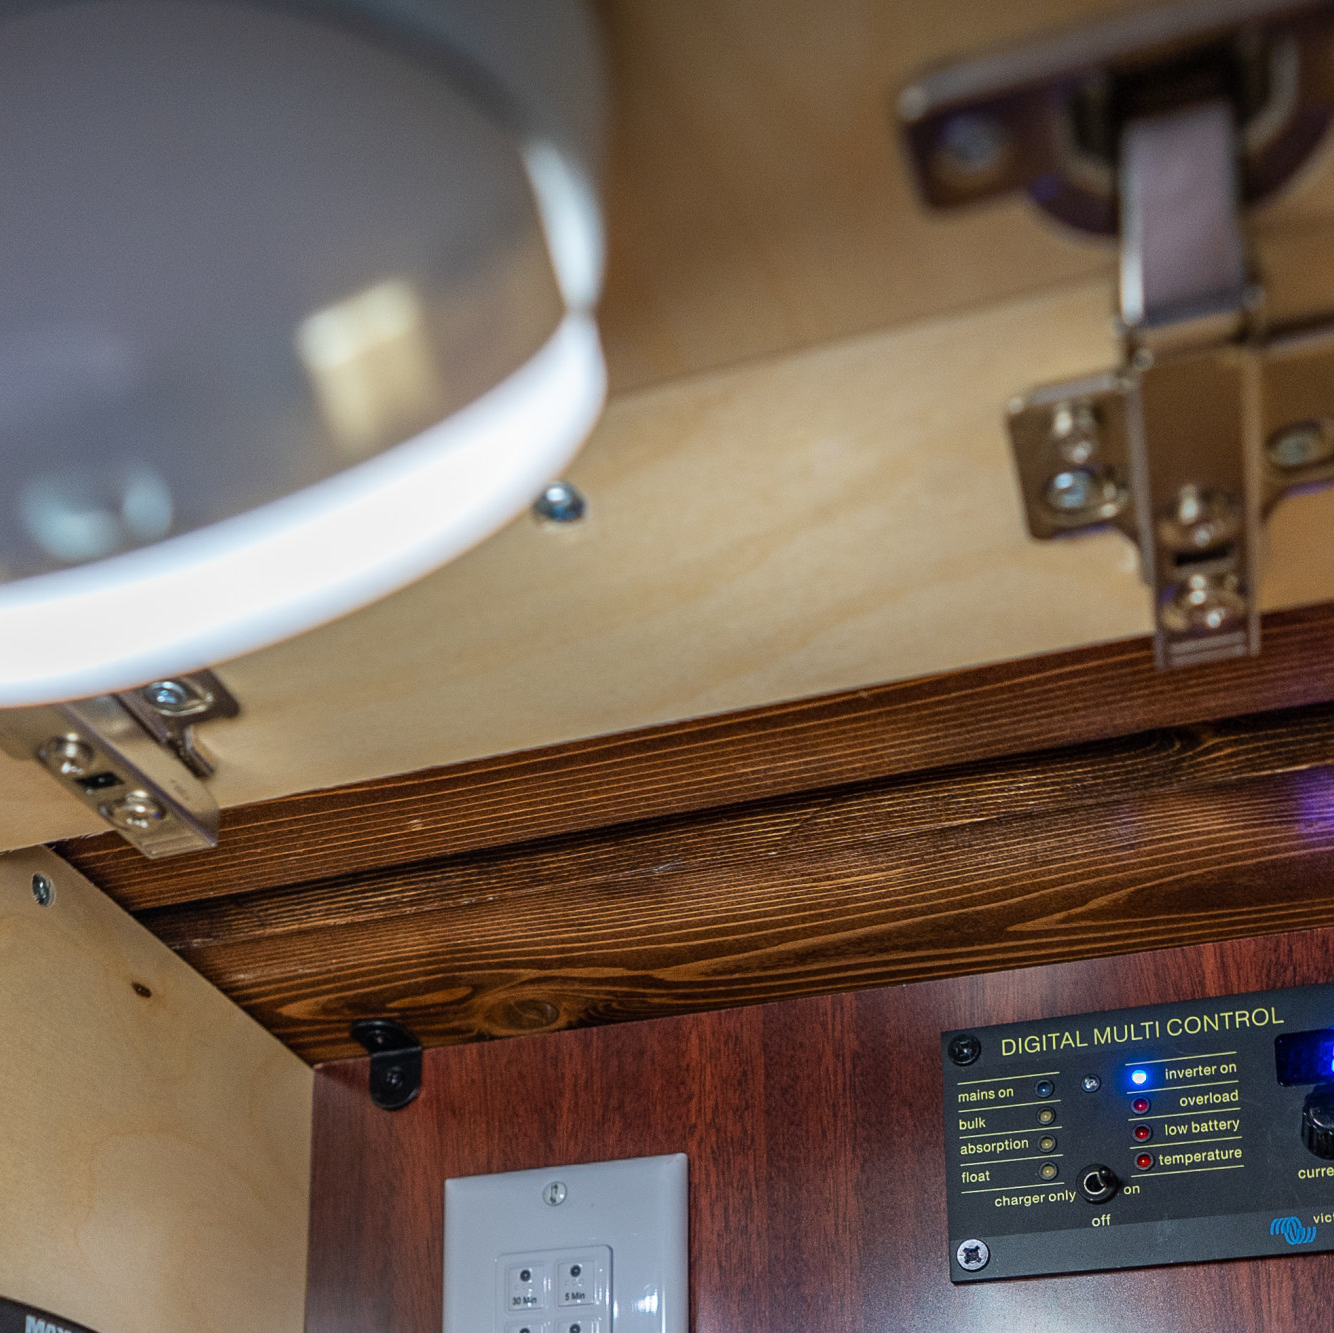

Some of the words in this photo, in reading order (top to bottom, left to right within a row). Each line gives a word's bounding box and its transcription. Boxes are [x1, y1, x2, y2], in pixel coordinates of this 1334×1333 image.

[1001, 1030, 1089, 1056] DIGITAL
[1093, 1020, 1160, 1046] MULTI
[1166, 1006, 1285, 1036] CONTROL
[1165, 1065, 1217, 1080] inverter
[1219, 1063, 1238, 1074] on
[957, 1089, 996, 1103] mains
[997, 1087, 1015, 1099] on
[1179, 1089, 1239, 1107] overload
[958, 1116, 987, 1130] bulk
[1164, 1124, 1188, 1136] low
[1191, 1119, 1240, 1134] battery
[960, 1138, 1029, 1155] absorption
[1158, 1148, 1243, 1166] temperature
[961, 1170, 991, 1184] float
[994, 1194, 1046, 1207] charger
[1048, 1189, 1077, 1203] only
[1123, 1185, 1141, 1195] on
[1091, 1213, 1112, 1227] off
[571, 1291, 586, 1301] Min
